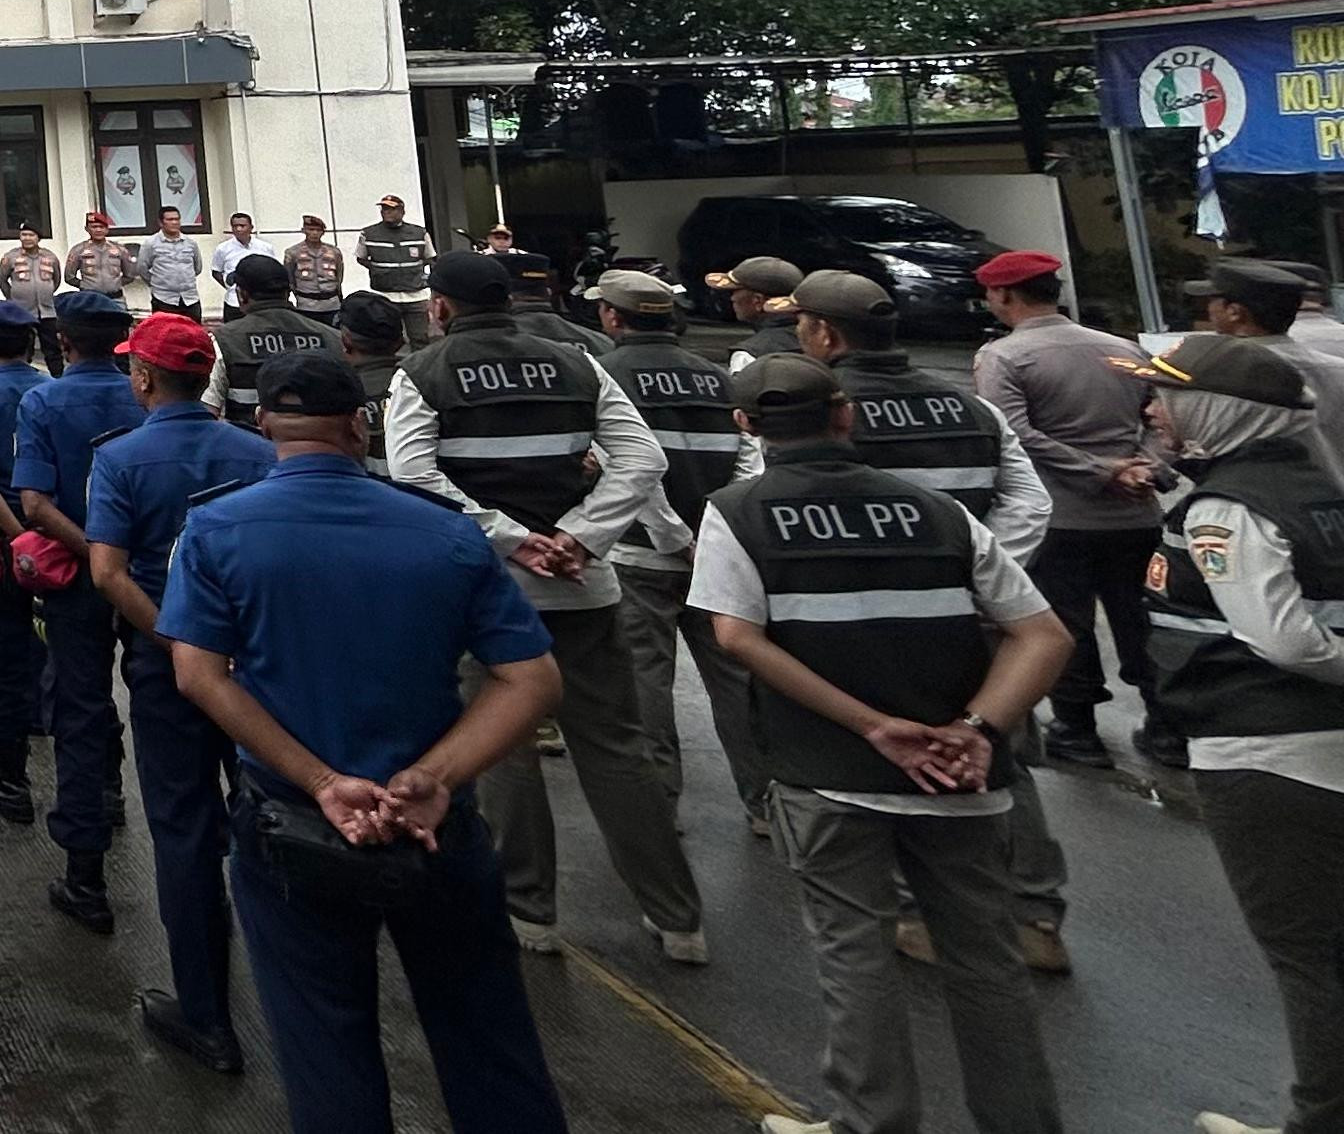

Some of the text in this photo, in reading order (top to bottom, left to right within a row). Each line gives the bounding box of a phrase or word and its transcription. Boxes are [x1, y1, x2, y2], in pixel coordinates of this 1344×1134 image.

[1154, 51, 1216, 77] KOJA
[456, 363, 558, 394] POL PP
[637, 372, 720, 398] POL PP
[862, 397, 964, 429] POL PP
[771, 502, 922, 542] POL PP
